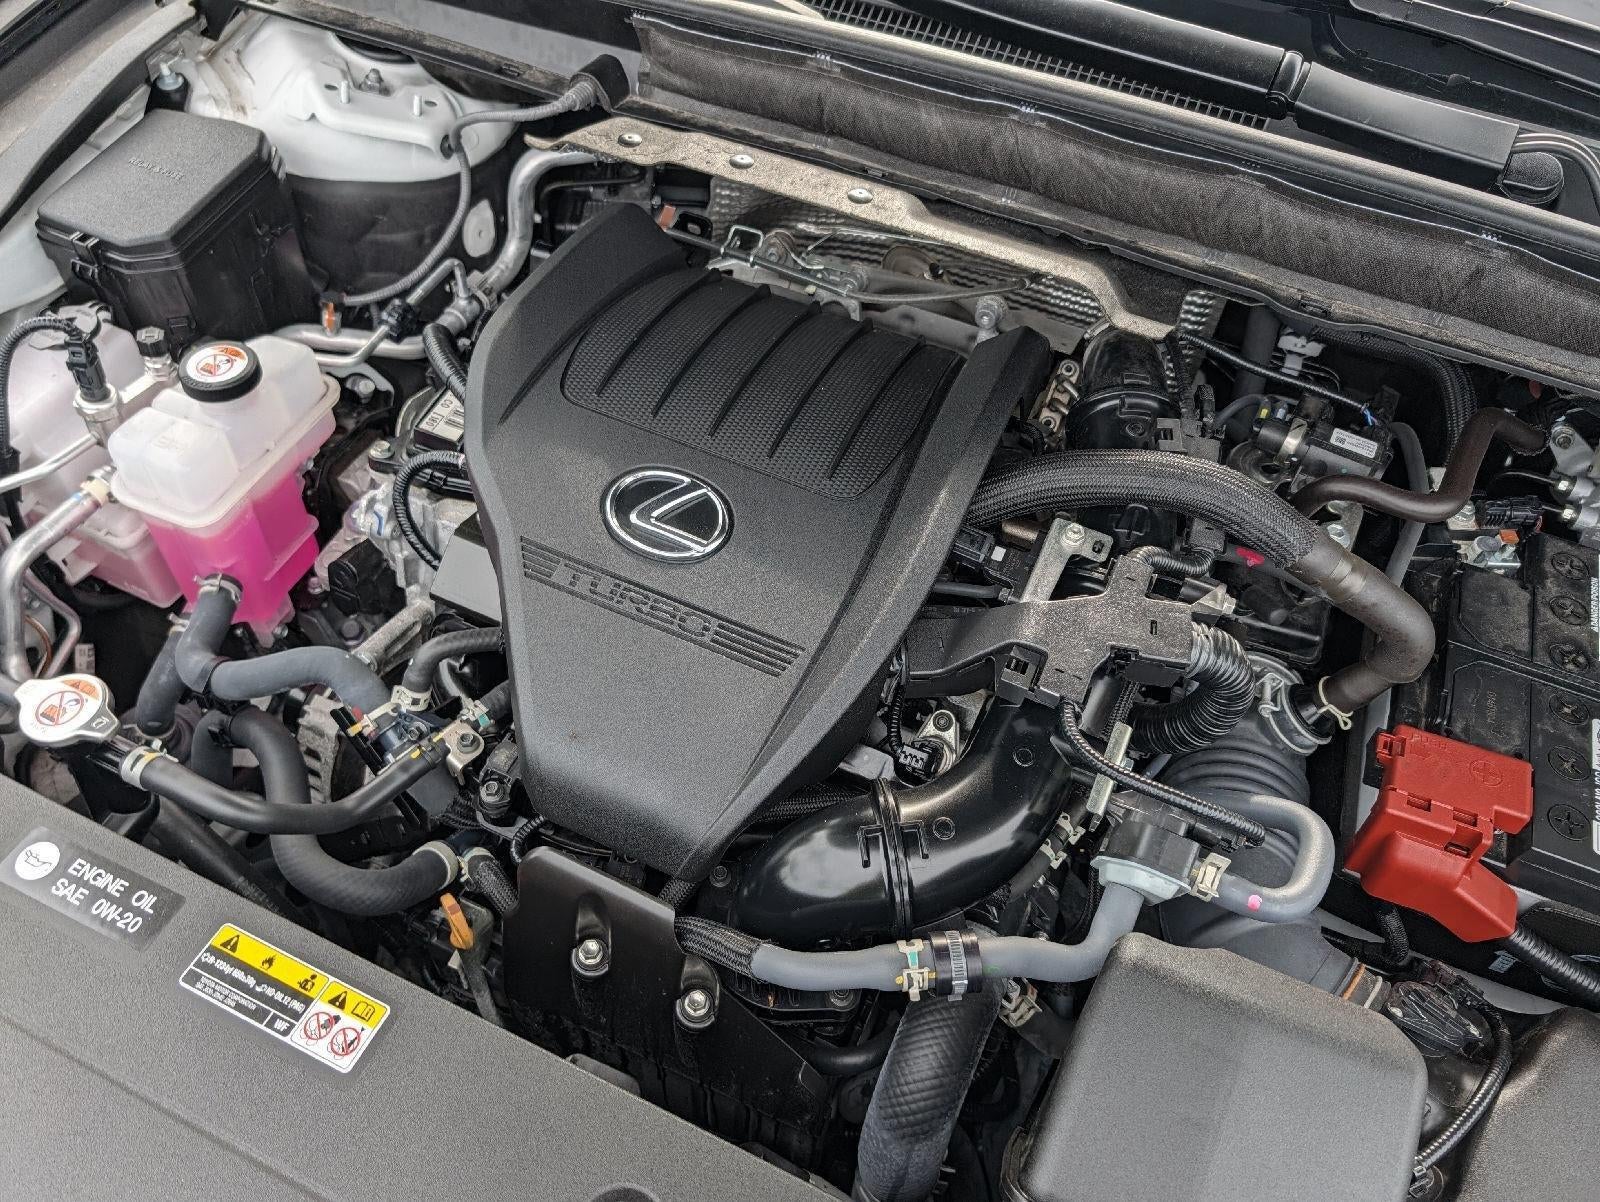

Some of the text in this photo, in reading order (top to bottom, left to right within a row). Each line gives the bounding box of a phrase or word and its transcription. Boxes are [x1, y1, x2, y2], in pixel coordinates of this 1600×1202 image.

[558, 561, 712, 638] TURBO
[51, 878, 142, 933] SAE 0W-20
[67, 857, 157, 914] ENGINE OIL
[273, 1017, 291, 1032] WF
